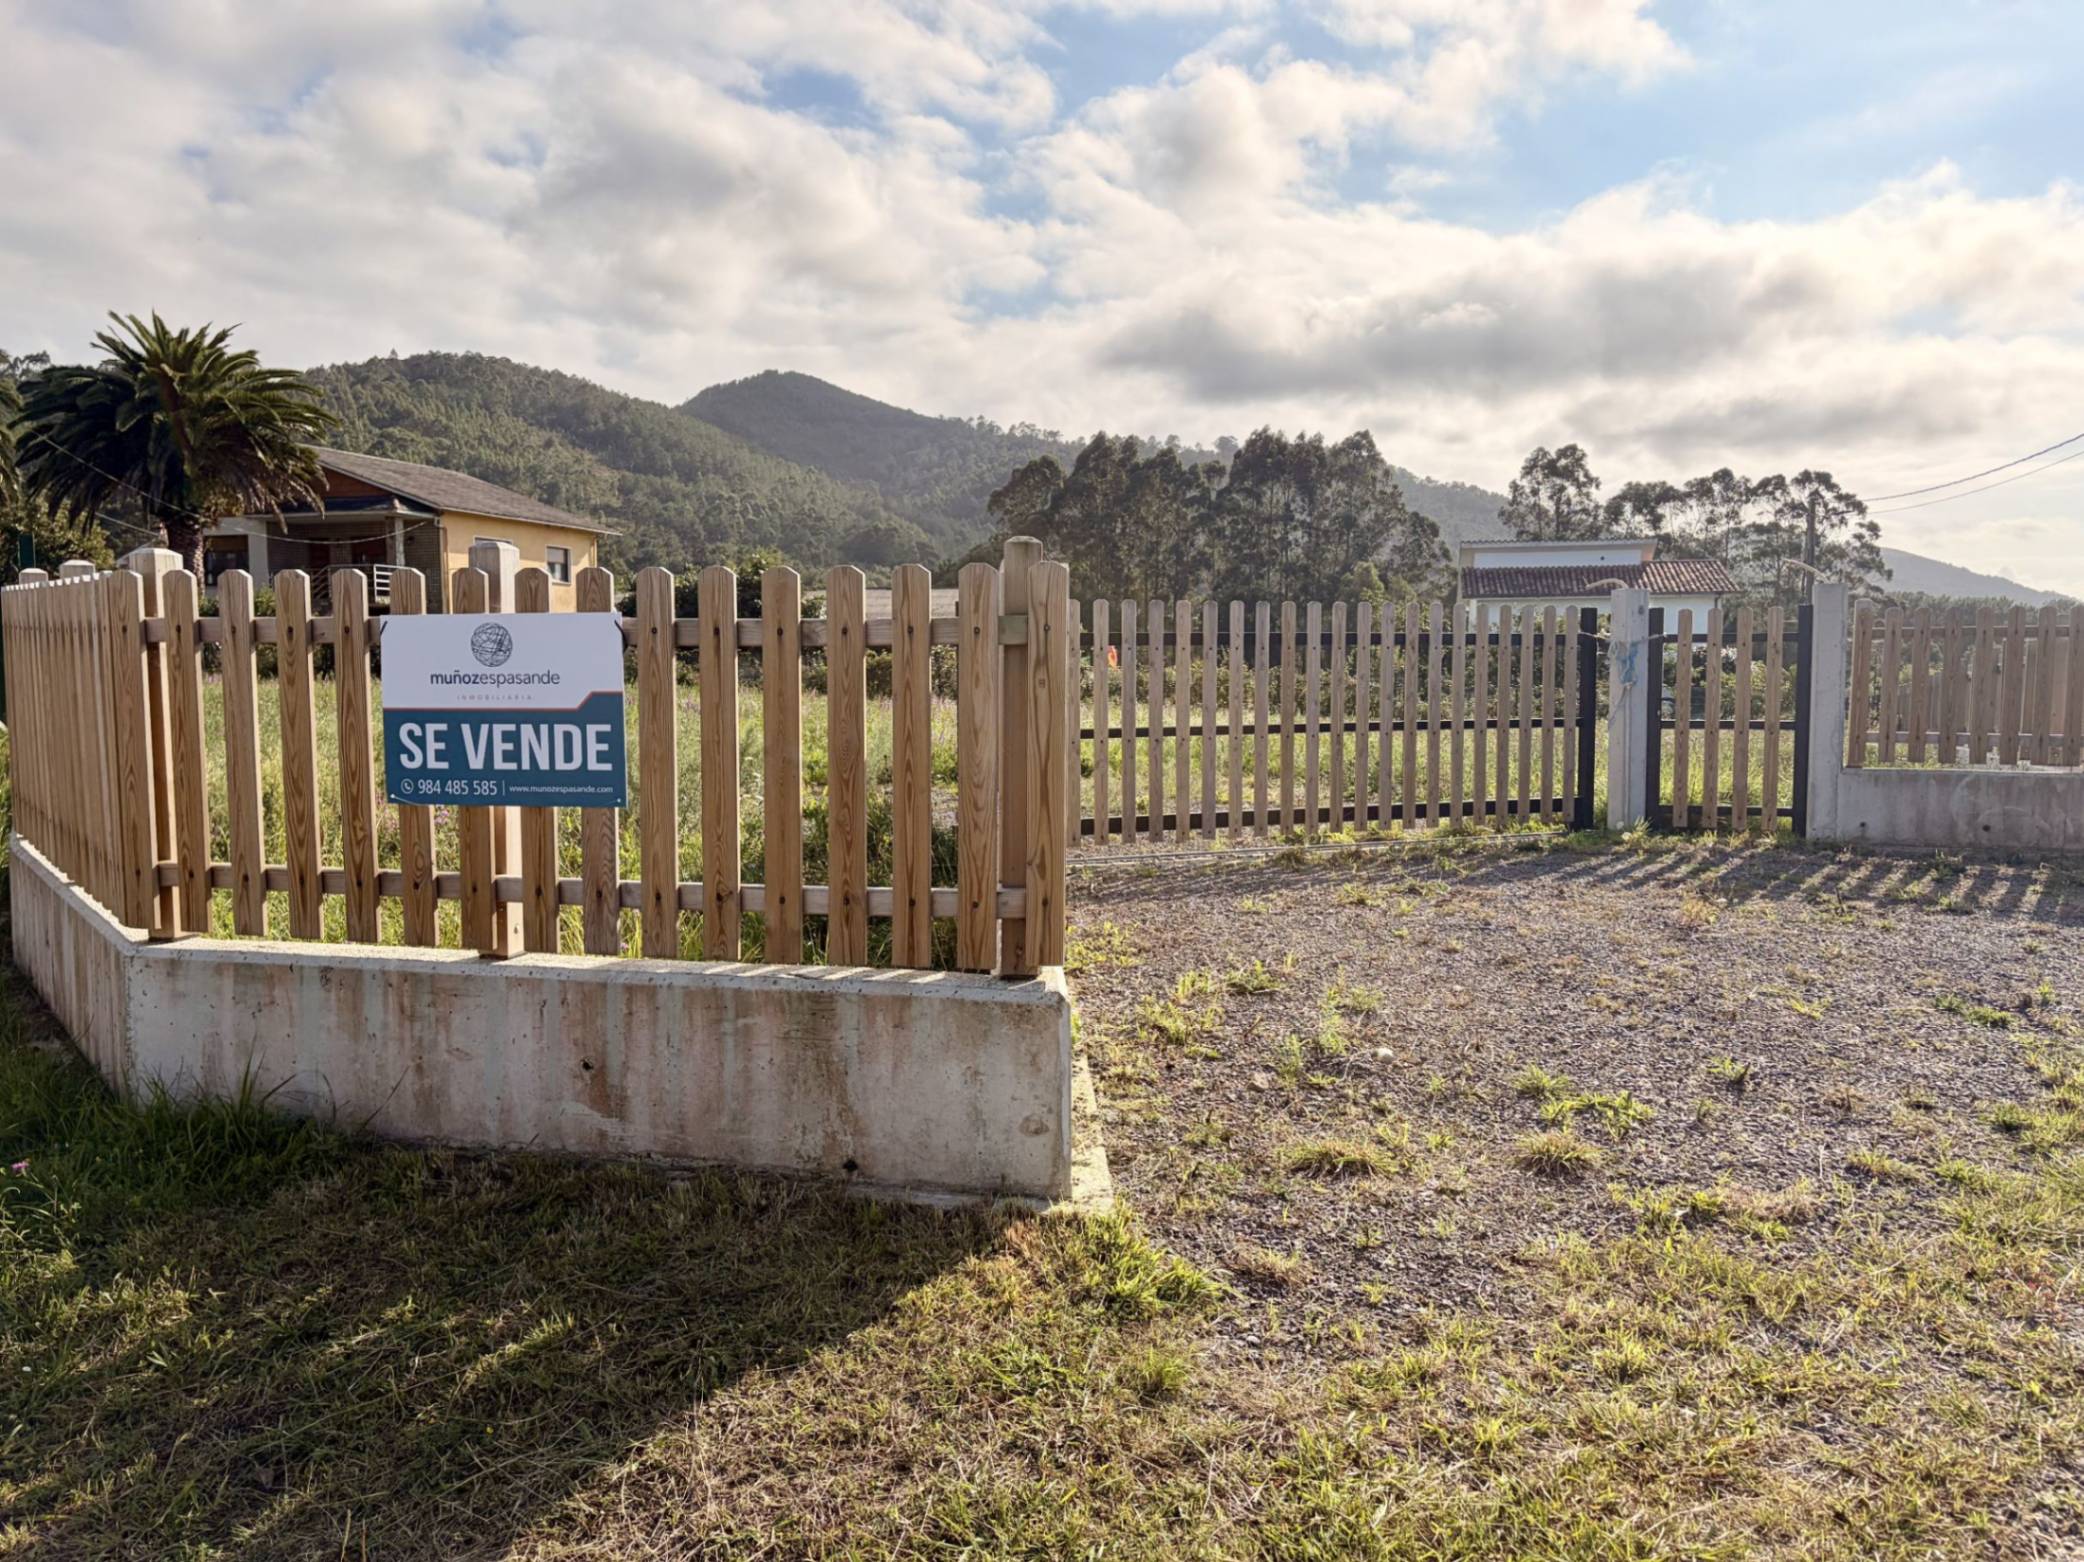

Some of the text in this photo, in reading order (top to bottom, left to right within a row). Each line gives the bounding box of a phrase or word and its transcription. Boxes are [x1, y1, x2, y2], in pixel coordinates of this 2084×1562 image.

[430, 669, 561, 688] muñozespasande
[398, 722, 613, 771] SE VENDE
[417, 779, 614, 796] 984 485 585 www.munozespasande.com
